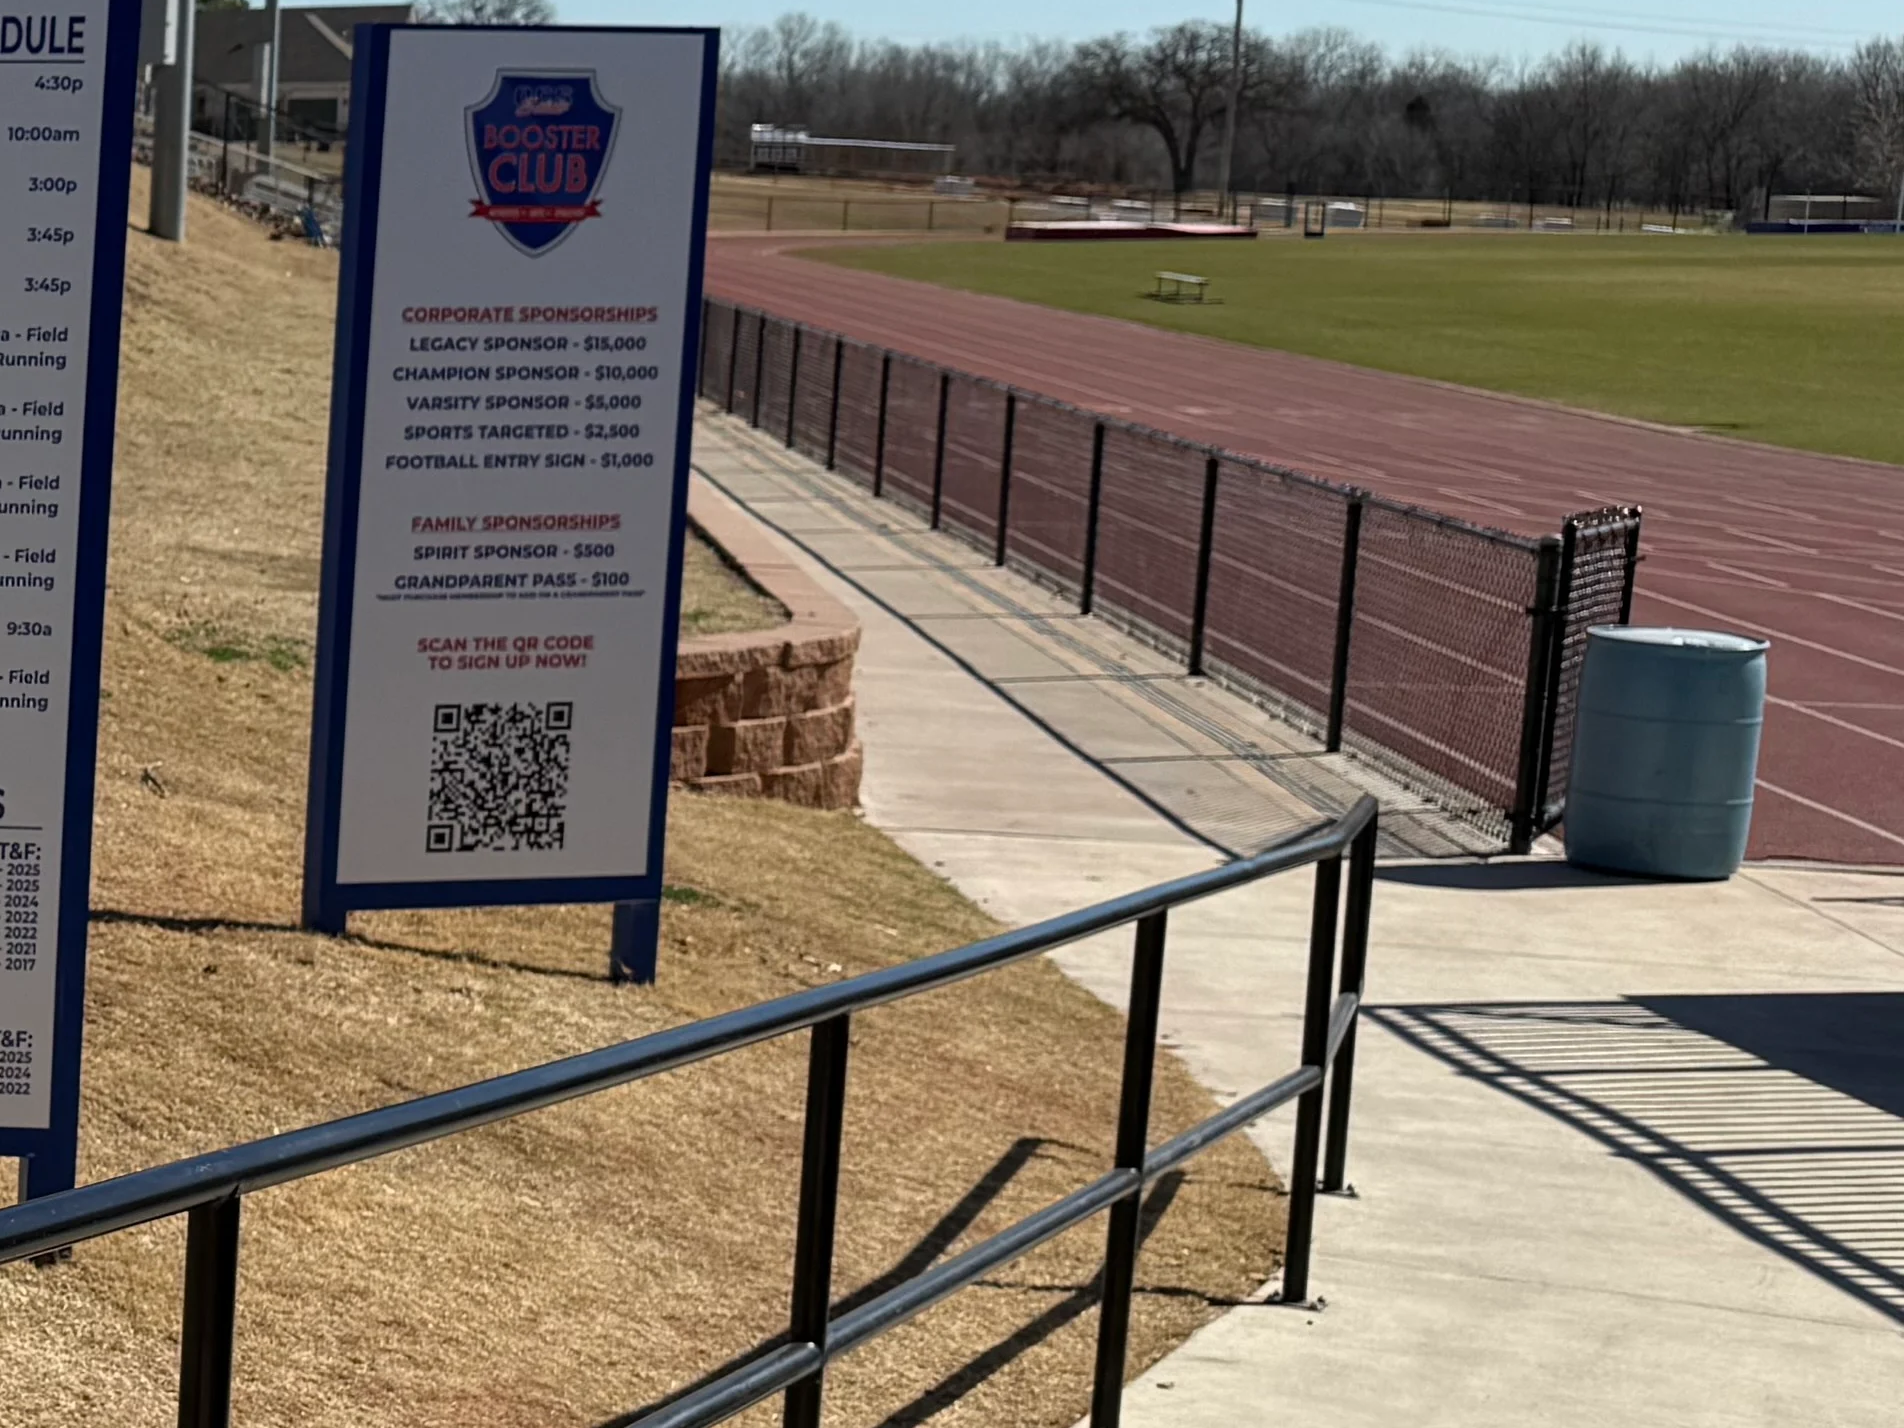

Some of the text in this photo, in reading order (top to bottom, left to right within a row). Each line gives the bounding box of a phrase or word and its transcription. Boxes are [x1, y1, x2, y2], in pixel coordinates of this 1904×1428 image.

[34, 76, 84, 94] 4:30p
[8, 126, 80, 142] 10:00am
[483, 124, 601, 152] BOOSTER
[488, 152, 589, 194] CLUB
[28, 177, 78, 196] 3:00p
[27, 227, 75, 246] 3:45p
[24, 277, 72, 297] 3:45p
[402, 307, 658, 323] CORPORATE SPONSORSHIPS
[409, 336, 479, 352] LEGACY
[483, 336, 569, 352] SPONSOR
[583, 335, 647, 353] $15,000
[392, 366, 491, 382] CHAMPION
[495, 365, 580, 381] SPONSOR
[595, 365, 659, 382] $10,000
[22, 400, 65, 417] Field
[406, 395, 481, 411] VARSITY
[485, 395, 570, 411] SPONSOR
[585, 394, 642, 411] $5,000
[404, 424, 474, 441] SPORTS
[478, 424, 570, 440] TARGETED
[584, 423, 641, 441] $2,500
[385, 454, 479, 470] FOOTBALL
[483, 454, 541, 469] ENTRY
[544, 453, 586, 469] SIGN
[600, 452, 654, 469] $1,000
[411, 514, 621, 533] FAMILY SPONSORSHIPS
[413, 545, 470, 561] SPIRIT
[473, 544, 558, 560] SPONSOR
[573, 542, 615, 559] $500
[394, 573, 529, 590] GRANDPARENT
[532, 572, 577, 588] PASS
[591, 571, 630, 588] $100
[6, 621, 53, 637] 9:30a
[417, 635, 594, 654] SCAN THE QR CODE
[428, 653, 587, 671] TO SIGN UP NOW!
